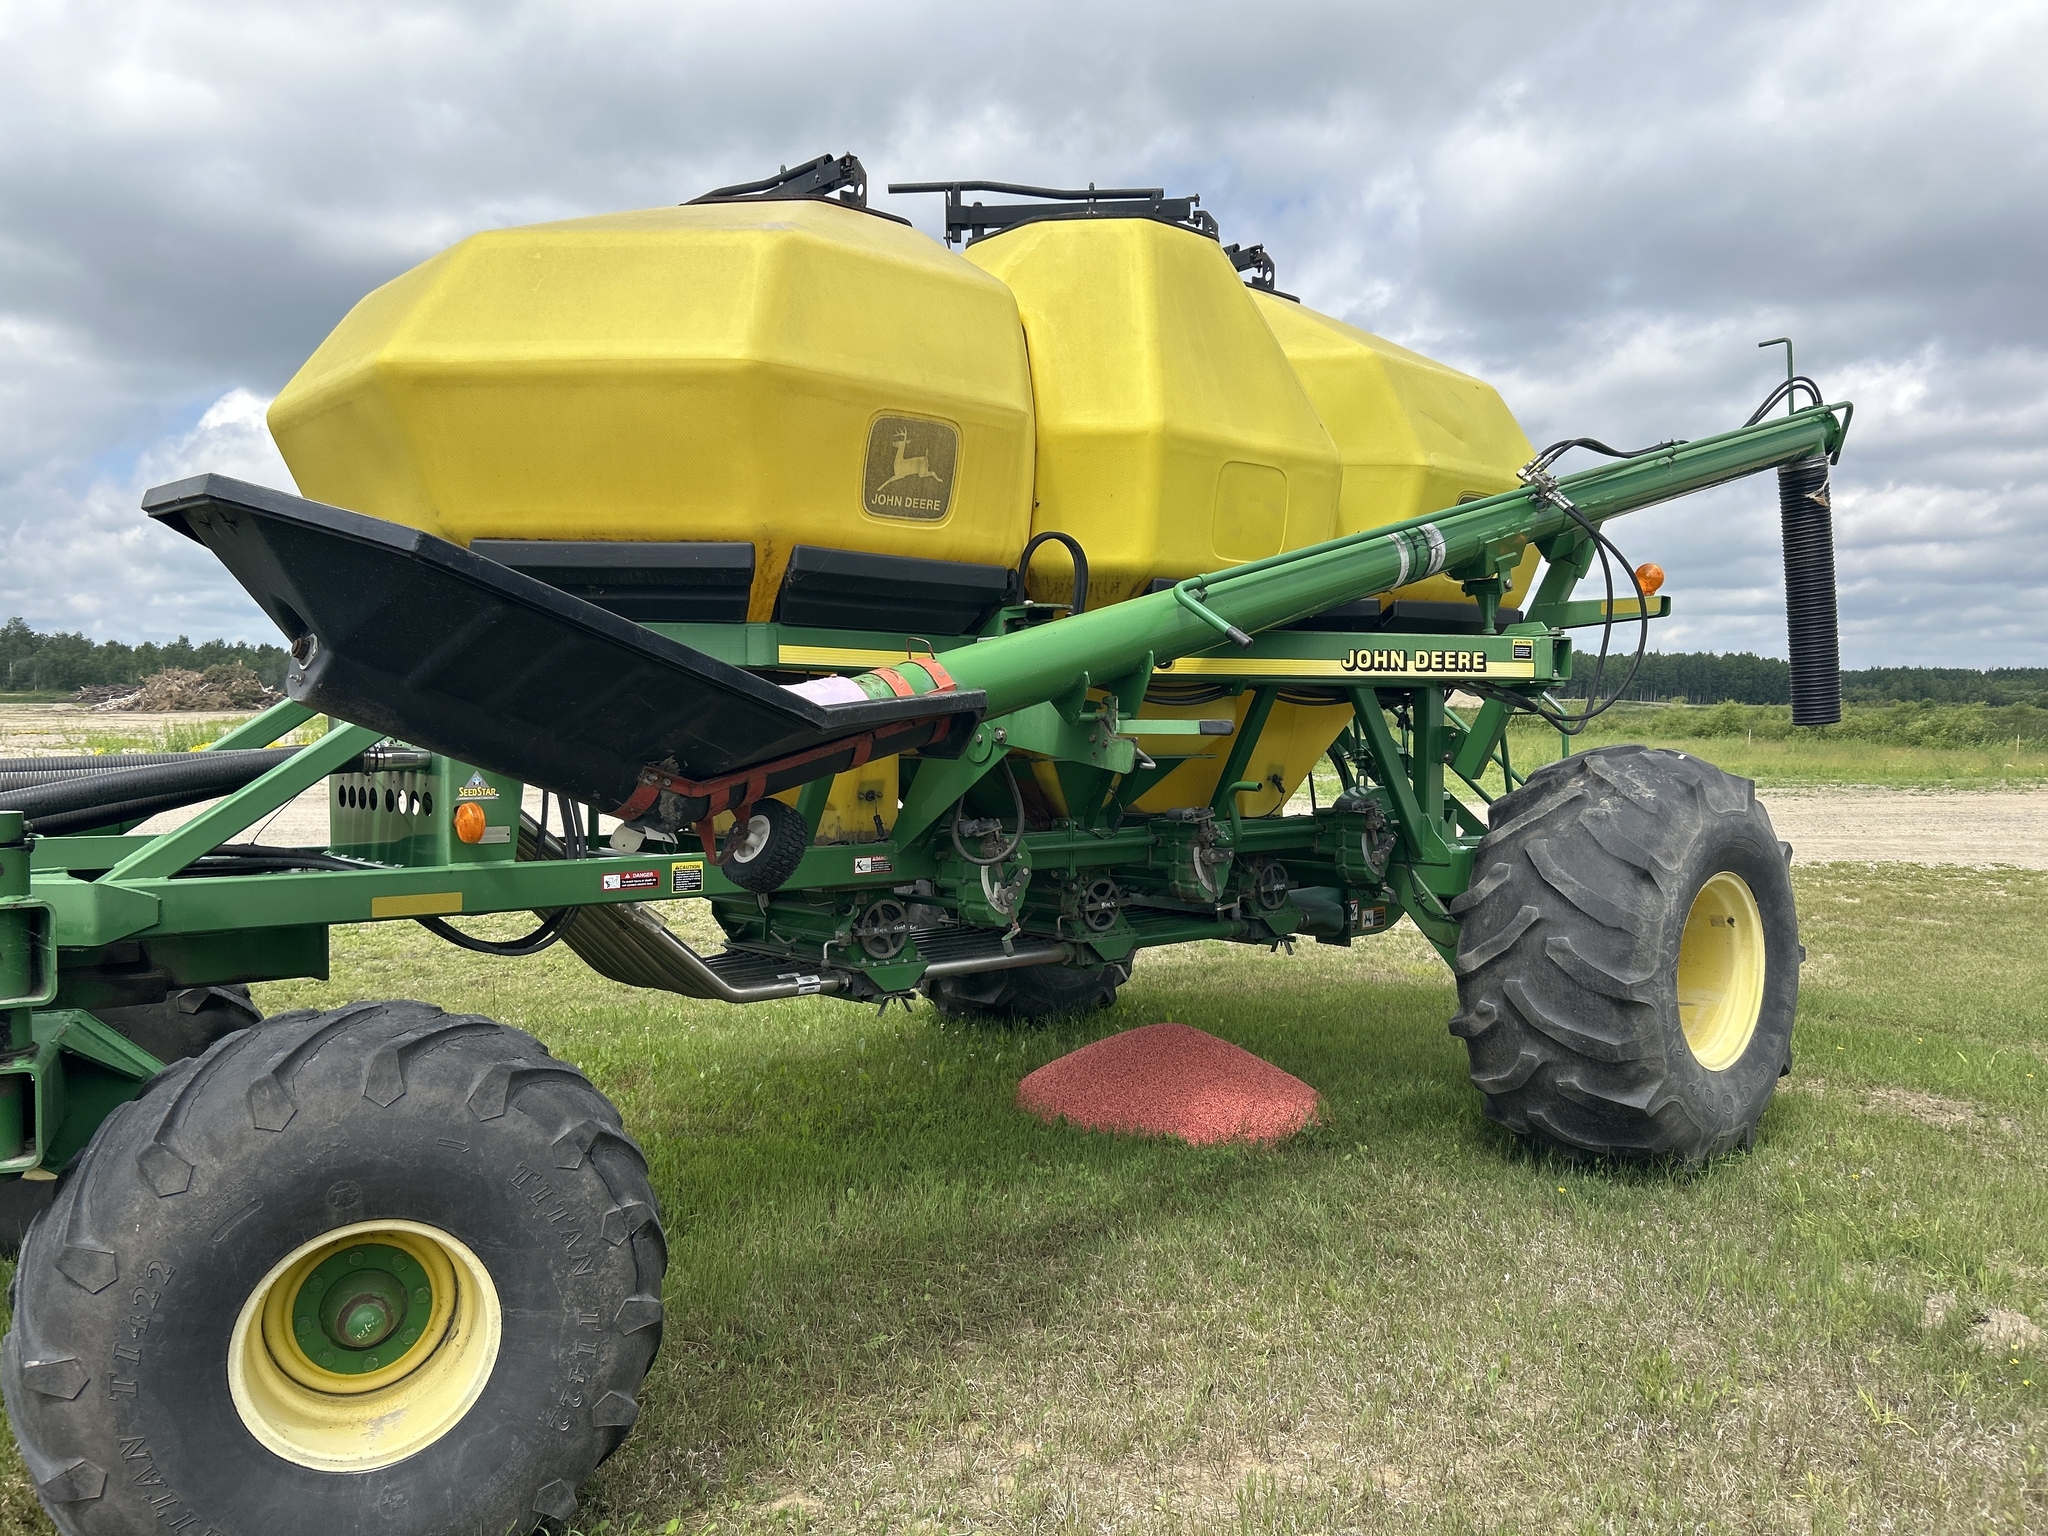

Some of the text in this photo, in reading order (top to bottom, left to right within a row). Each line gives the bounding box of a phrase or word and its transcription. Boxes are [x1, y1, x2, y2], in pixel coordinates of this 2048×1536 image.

[871, 493, 941, 511] JOHN DEERE
[1341, 649, 1487, 672] JOHN DEERE
[107, 1261, 176, 1401] TI422
[508, 1161, 602, 1431] TITAN TI422
